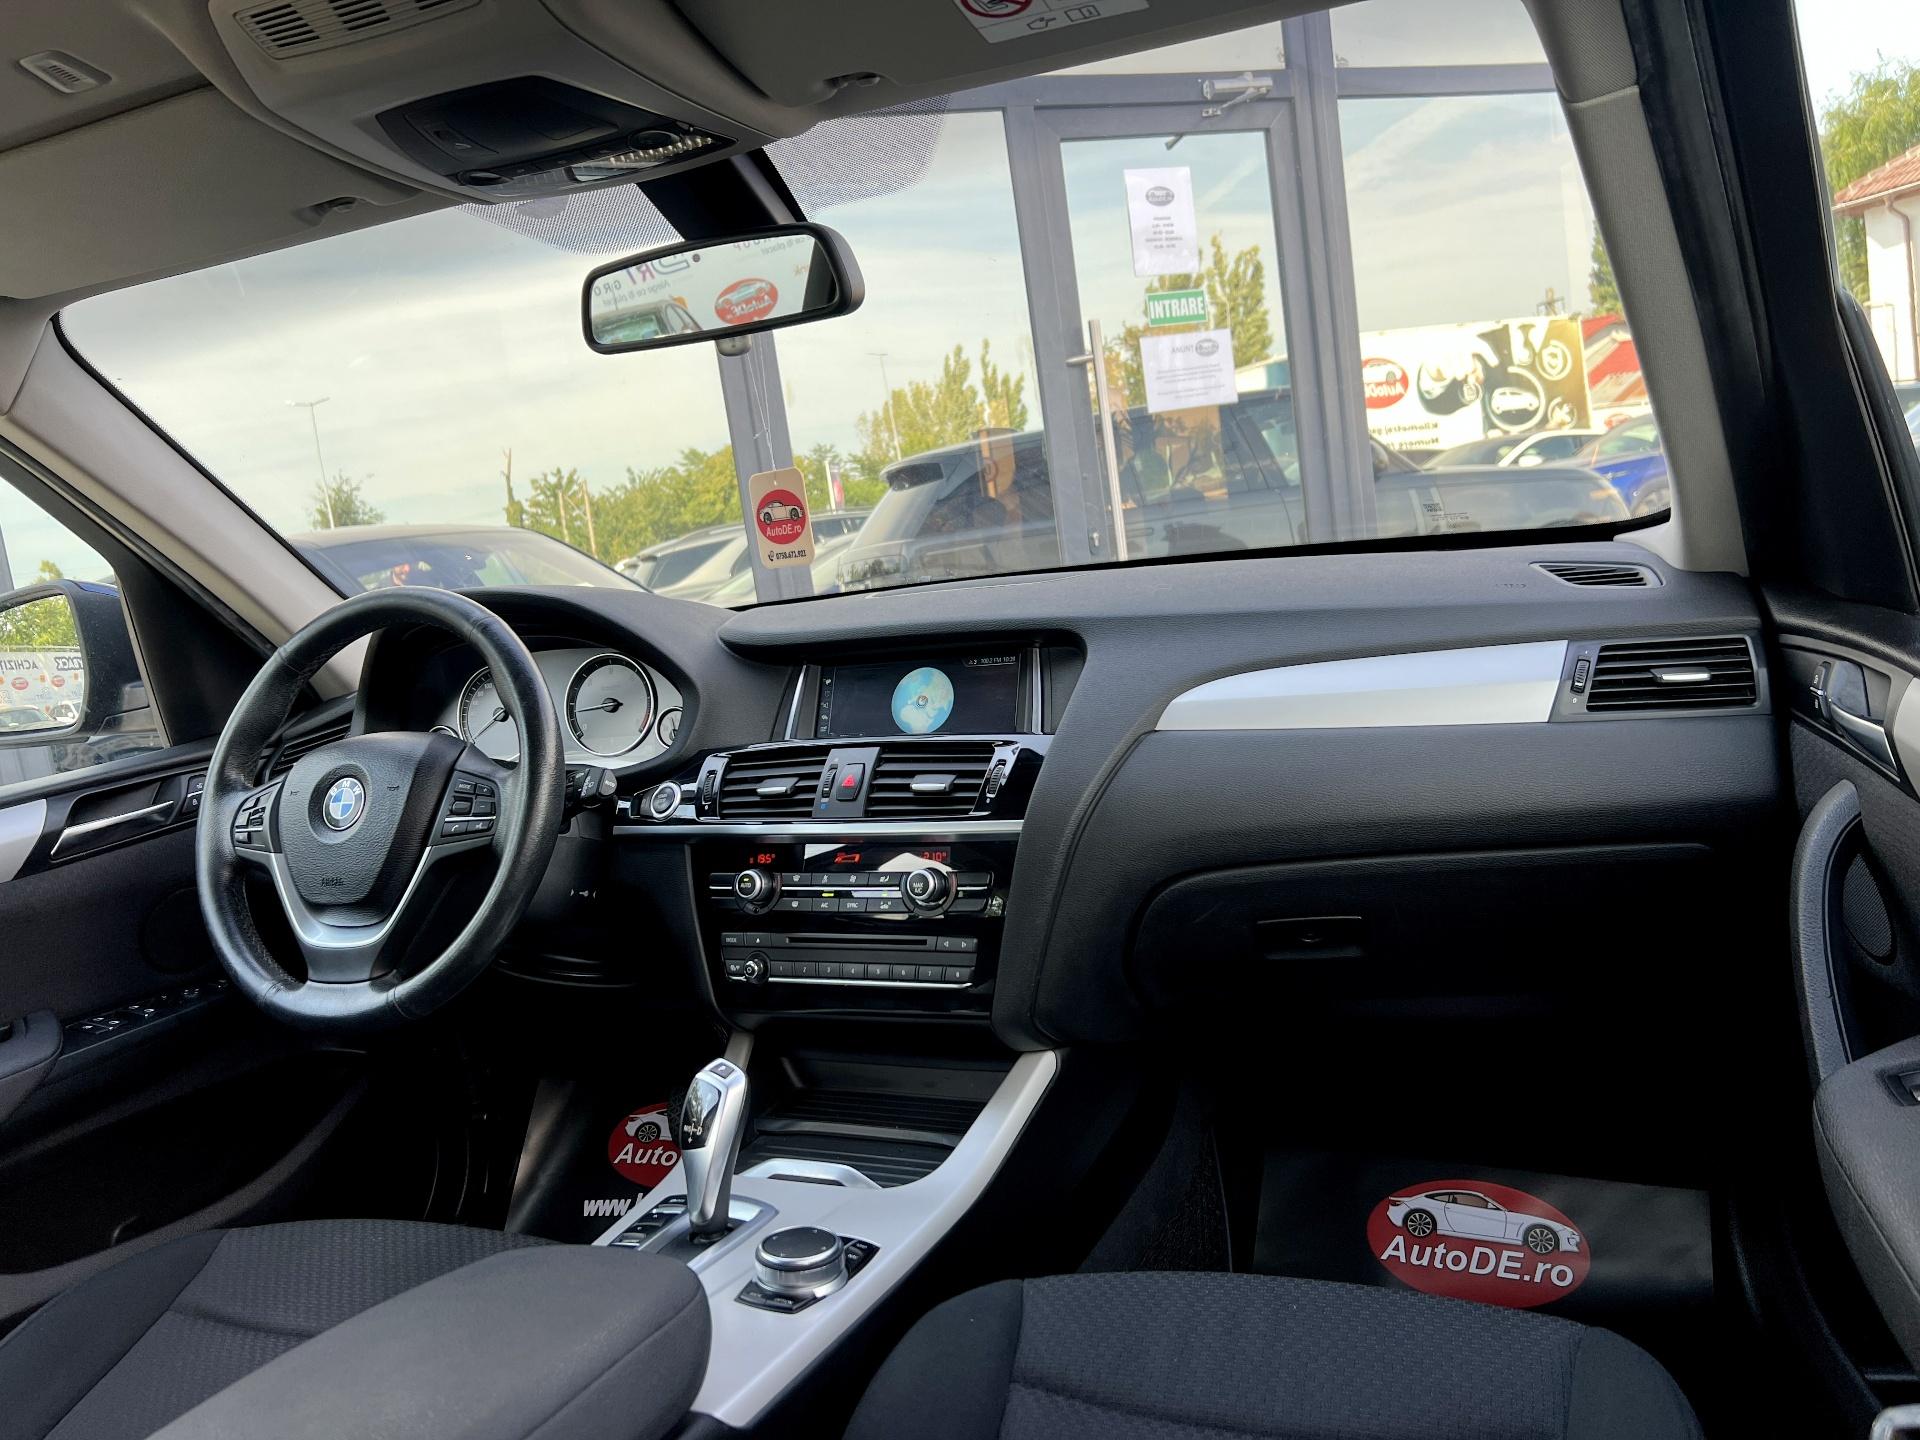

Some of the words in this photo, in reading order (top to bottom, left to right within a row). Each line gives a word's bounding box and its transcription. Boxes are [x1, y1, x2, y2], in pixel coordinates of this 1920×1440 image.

[1150, 296, 1204, 319] INTRARE
[766, 524, 802, 537] AutoDE.ro
[330, 780, 362, 796] BMW
[1380, 1234, 1574, 1288] AutoDE.ro
